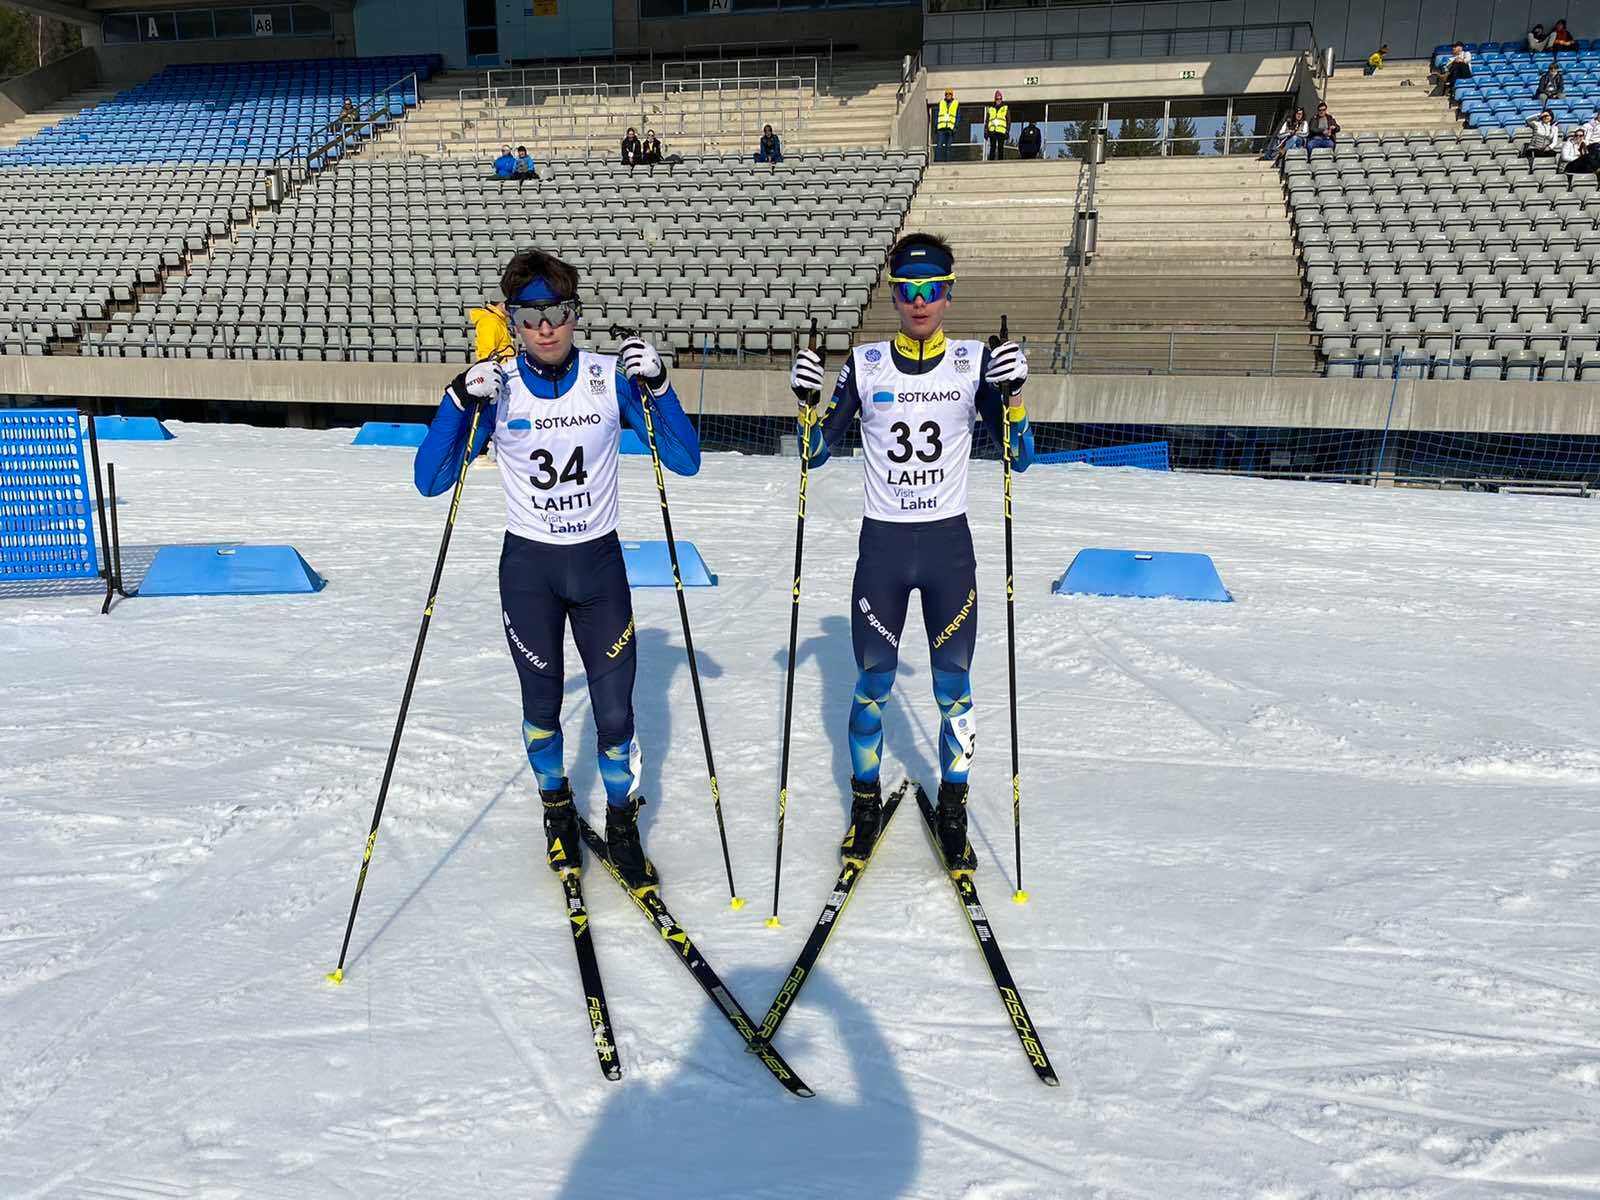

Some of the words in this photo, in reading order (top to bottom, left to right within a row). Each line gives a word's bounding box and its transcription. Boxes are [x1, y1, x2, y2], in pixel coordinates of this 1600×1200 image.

[147, 17, 159, 37] A
[255, 19, 272, 32] A8
[897, 390, 961, 404] SOTKAMO
[534, 413, 601, 430] SOTKAMO
[887, 420, 943, 463] 33
[529, 446, 588, 490] 34
[887, 468, 944, 486] LAHTI
[531, 491, 592, 511] LAHTI
[893, 488, 914, 498] Visit
[900, 496, 937, 510] Lahti
[540, 513, 562, 523] Visit
[550, 520, 587, 534] Lahti
[508, 627, 549, 670] sportful
[757, 966, 805, 1039] FISCHER
[587, 996, 612, 1062] FISCER
[1000, 985, 1048, 1068] FISCHER
[730, 1015, 791, 1080] FISHER
